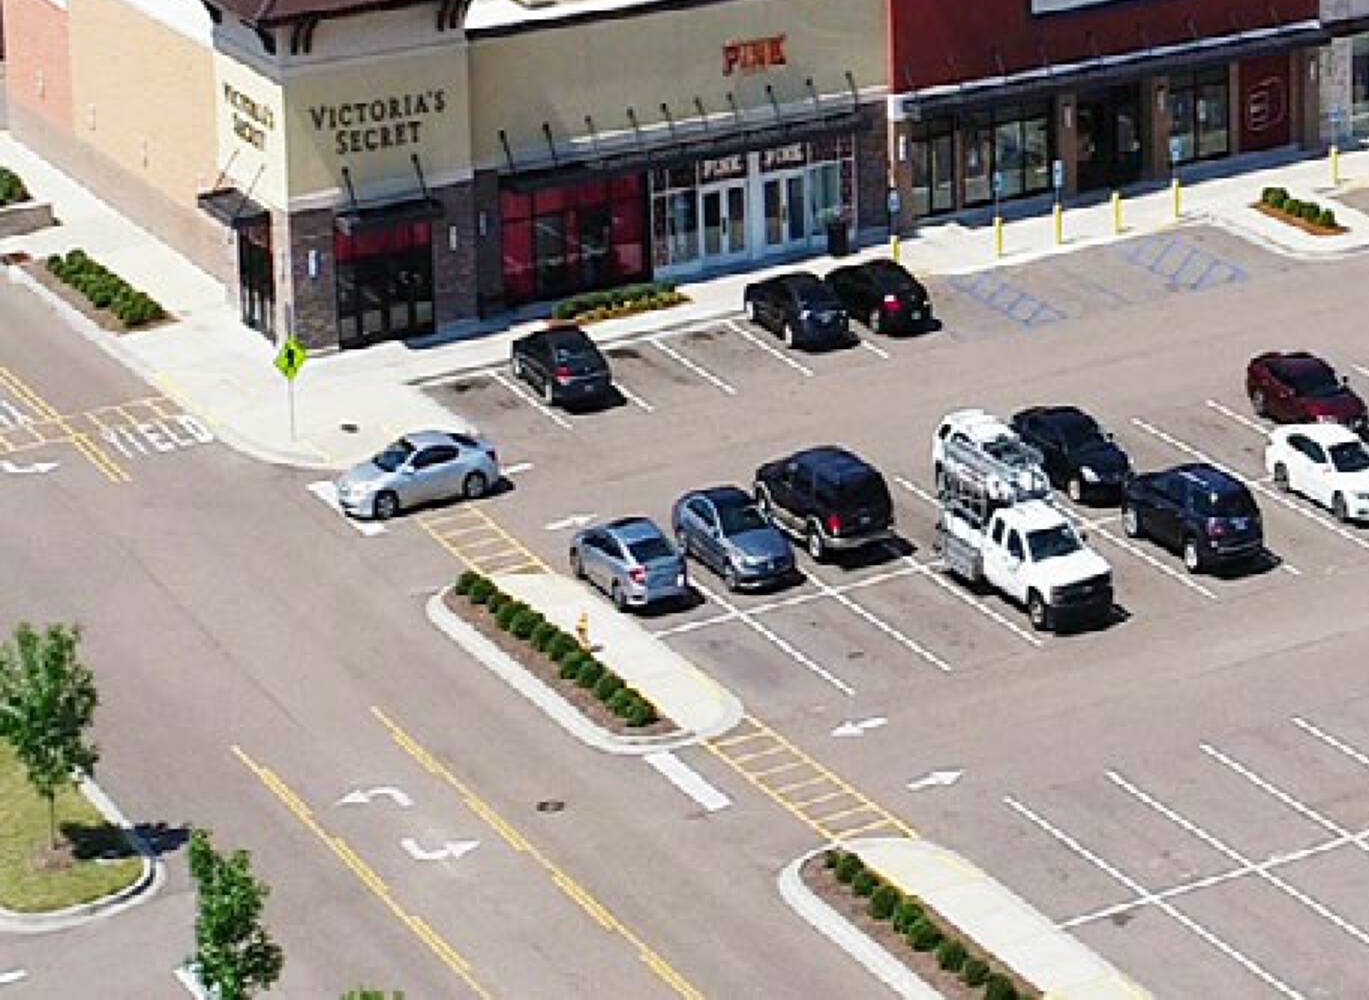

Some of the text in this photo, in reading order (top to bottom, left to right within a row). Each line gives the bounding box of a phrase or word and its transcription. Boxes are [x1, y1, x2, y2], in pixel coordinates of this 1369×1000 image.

[722, 31, 788, 77] PINK
[308, 88, 446, 131] VICTORIA'S
[335, 120, 422, 156] SECRET
